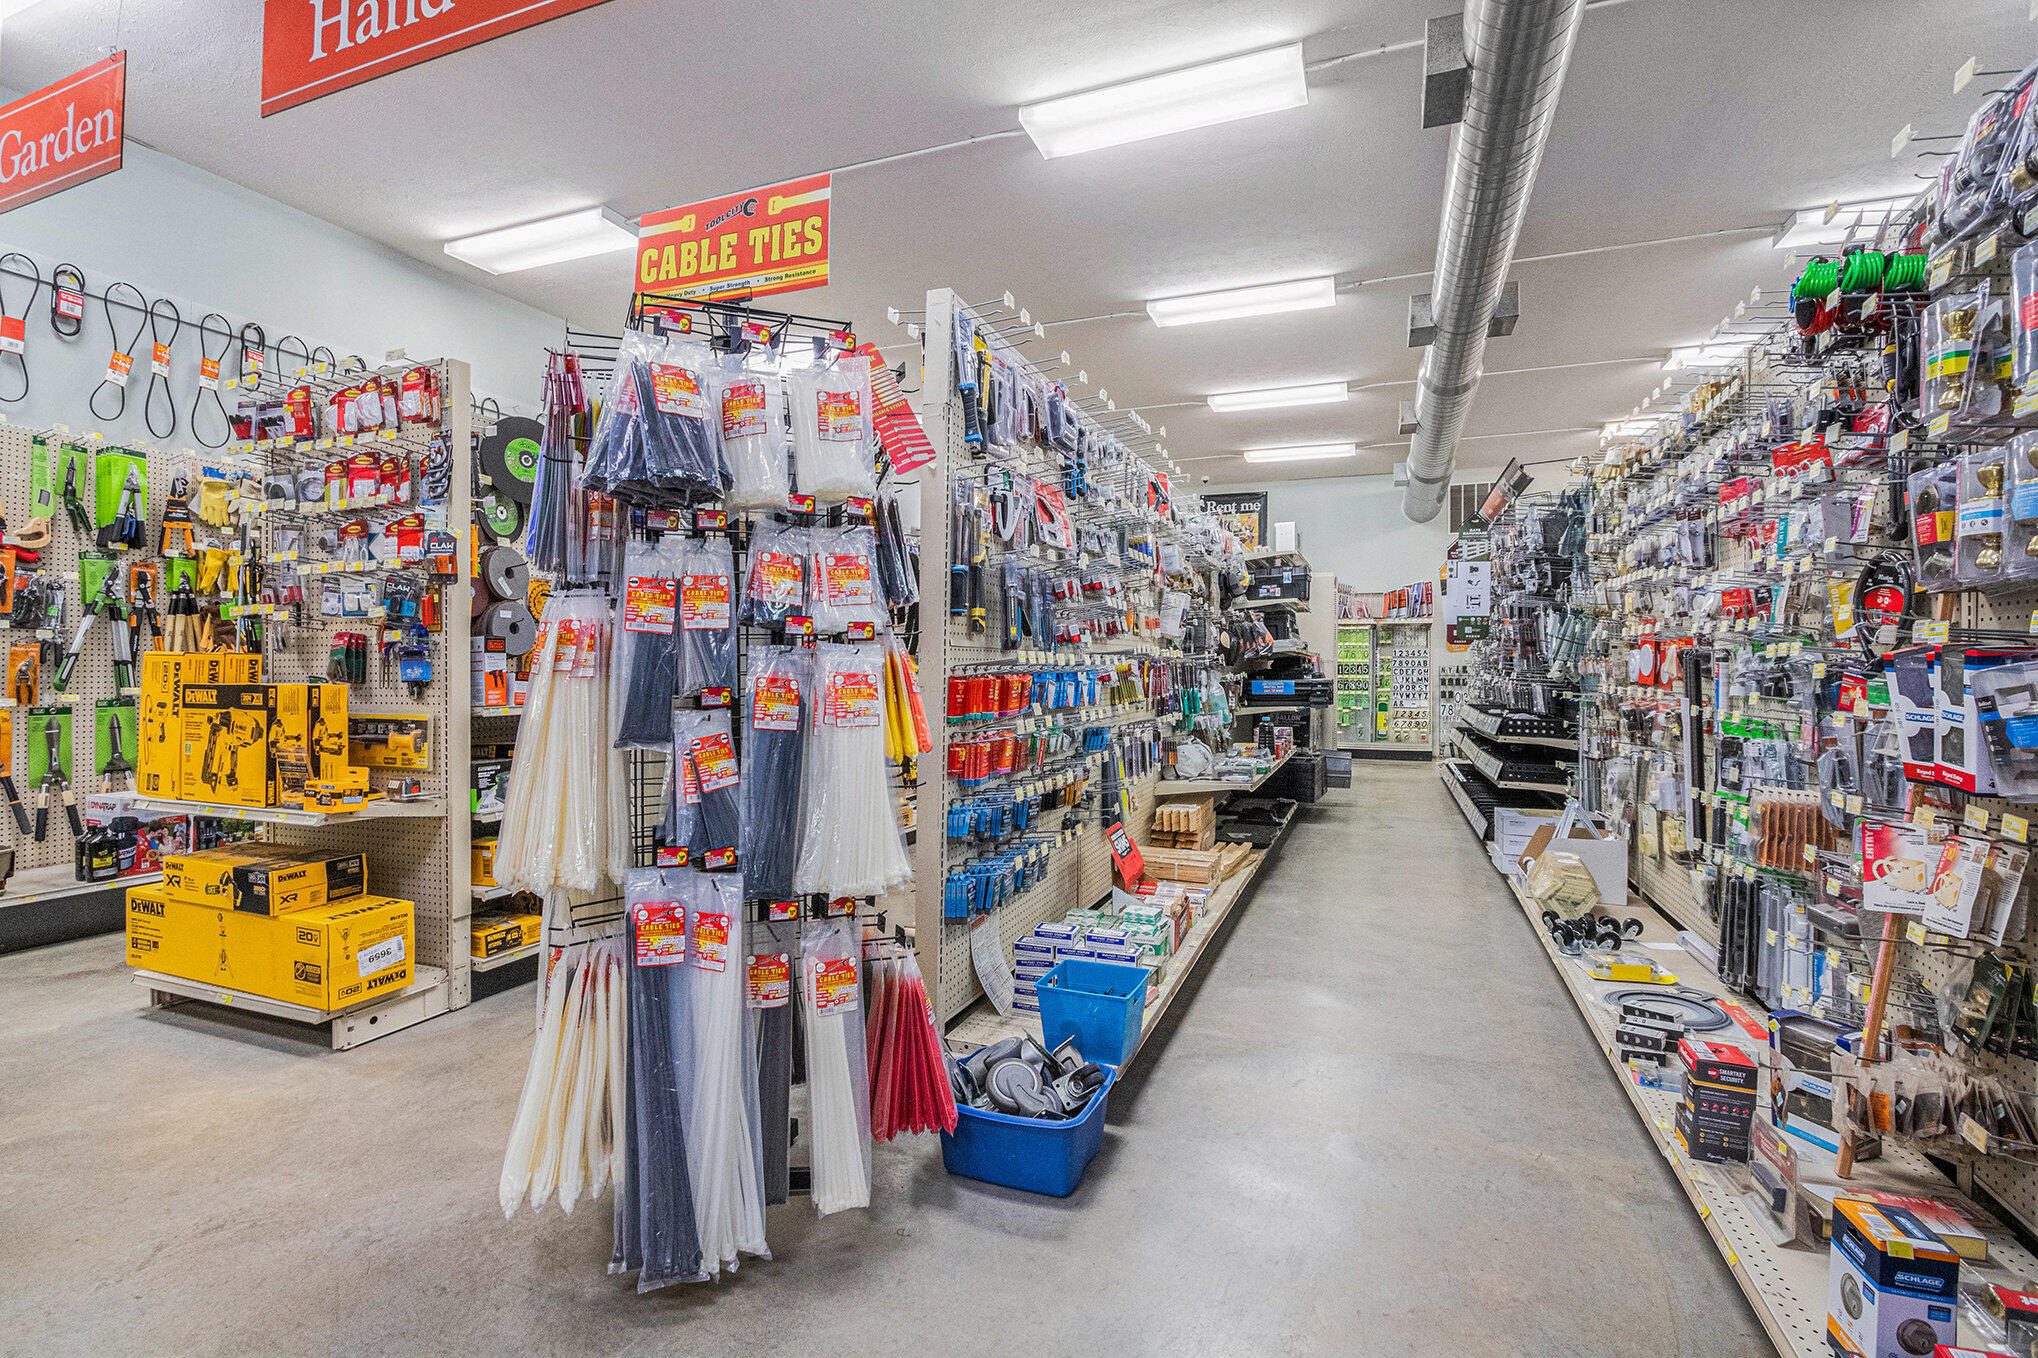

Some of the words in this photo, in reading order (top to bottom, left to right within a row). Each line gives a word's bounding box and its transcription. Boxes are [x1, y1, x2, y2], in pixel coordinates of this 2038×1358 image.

[309, 0, 456, 62] Han
[0, 103, 117, 184] Garden
[705, 213, 725, 231] TOOL
[726, 201, 746, 218] CITY
[640, 233, 738, 284] CABLE
[748, 215, 823, 265] TIES
[684, 289, 697, 297] Duty
[709, 283, 725, 292] Super
[727, 279, 751, 289] Strength
[764, 274, 784, 283] Strong
[784, 269, 817, 280] Resistance
[1206, 500, 1238, 514] Rent
[1241, 501, 1261, 511] me
[430, 541, 454, 550] CLAW
[385, 582, 411, 593] CLAW
[1830, 588, 1841, 613] PATIO
[172, 662, 181, 718] DEWALT
[185, 689, 218, 704] DEWALT
[1865, 830, 1874, 860] ENTRY
[165, 861, 184, 872] DEWALT
[166, 874, 181, 888] XR
[278, 870, 307, 883] DEWALT
[279, 893, 298, 906] XR
[131, 898, 165, 918] DEWALT
[641, 923, 664, 931] CABLE
[665, 922, 681, 930] TIES
[298, 930, 319, 943] 20V
[368, 947, 393, 963] 3659
[366, 969, 407, 990] DEWALT
[1719, 1068, 1746, 1078] SMARTKEY
[1720, 1075, 1744, 1084] SECURITY
[1896, 1273, 1943, 1286] SCHLAGE
